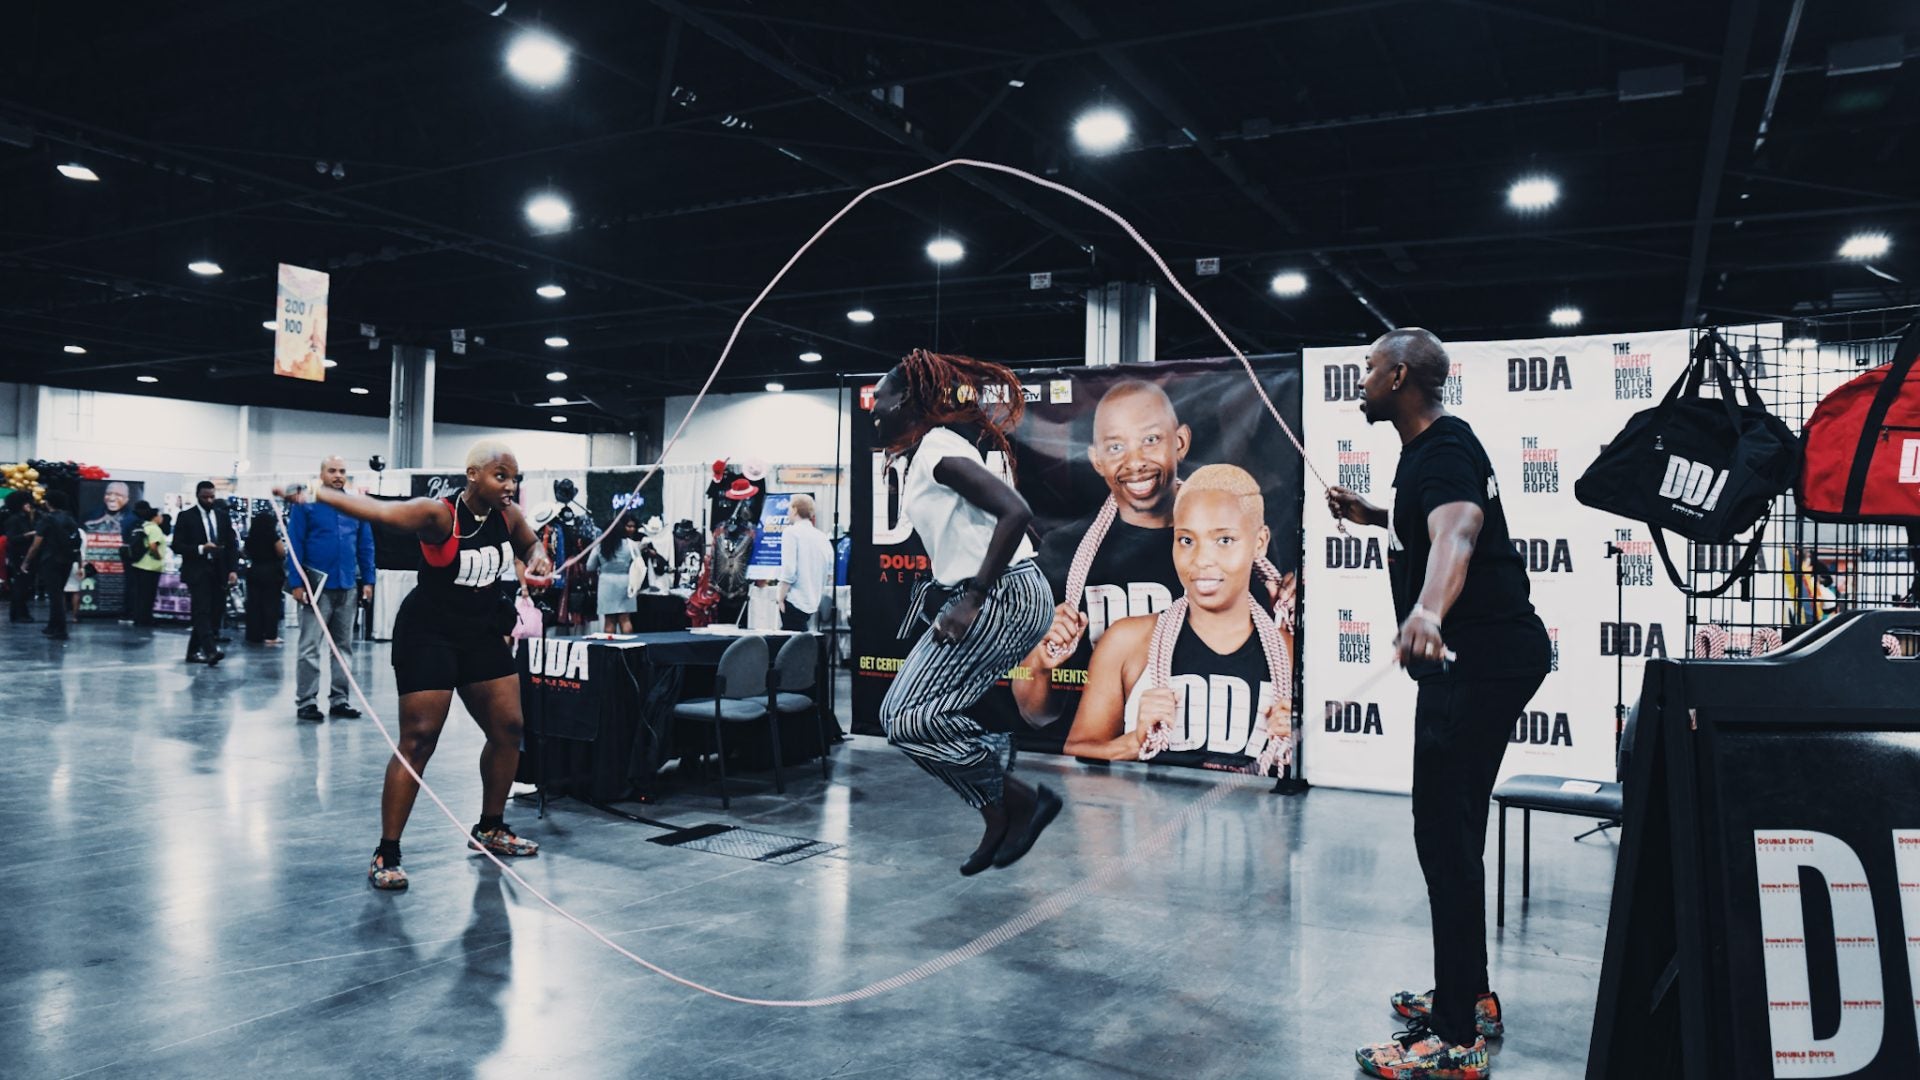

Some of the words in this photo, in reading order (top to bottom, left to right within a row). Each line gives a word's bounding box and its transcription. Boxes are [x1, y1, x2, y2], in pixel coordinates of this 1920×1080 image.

[285, 299, 305, 316] 200
[285, 318, 303, 334] 100
[1613, 342, 1630, 355] THE
[1615, 353, 1652, 368] PERFECT
[1508, 356, 1573, 392] DDA
[1615, 367, 1652, 378] DOUBLE
[1615, 377, 1652, 389] DUTCH
[1615, 388, 1652, 400] ROPES
[1337, 440, 1352, 451] THE
[1521, 437, 1538, 449] THE
[1339, 452, 1371, 464] PERFECT
[1523, 449, 1559, 461] PERFECT
[1339, 463, 1371, 474] DOUBLE
[1523, 461, 1559, 472] DOUBLE
[1339, 473, 1371, 484] DUTCH
[1523, 472, 1559, 483] DUTCH
[1523, 482, 1559, 493] ROPES
[1615, 529, 1632, 541] THE
[1326, 537, 1383, 570] DDA
[1337, 609, 1352, 621] THE
[1339, 622, 1371, 634] PERFECT
[1339, 633, 1371, 644] DOUBLE
[1600, 621, 1667, 658] DDA
[1339, 643, 1371, 654] DUTCH
[860, 656, 876, 669] GET
[1339, 653, 1371, 664] ROPES
[1325, 701, 1384, 736] DDA
[1757, 837, 1786, 845] DOUBLE
[1789, 837, 1814, 845] DUTCH
[1808, 1050, 1835, 1058] DUTCH
